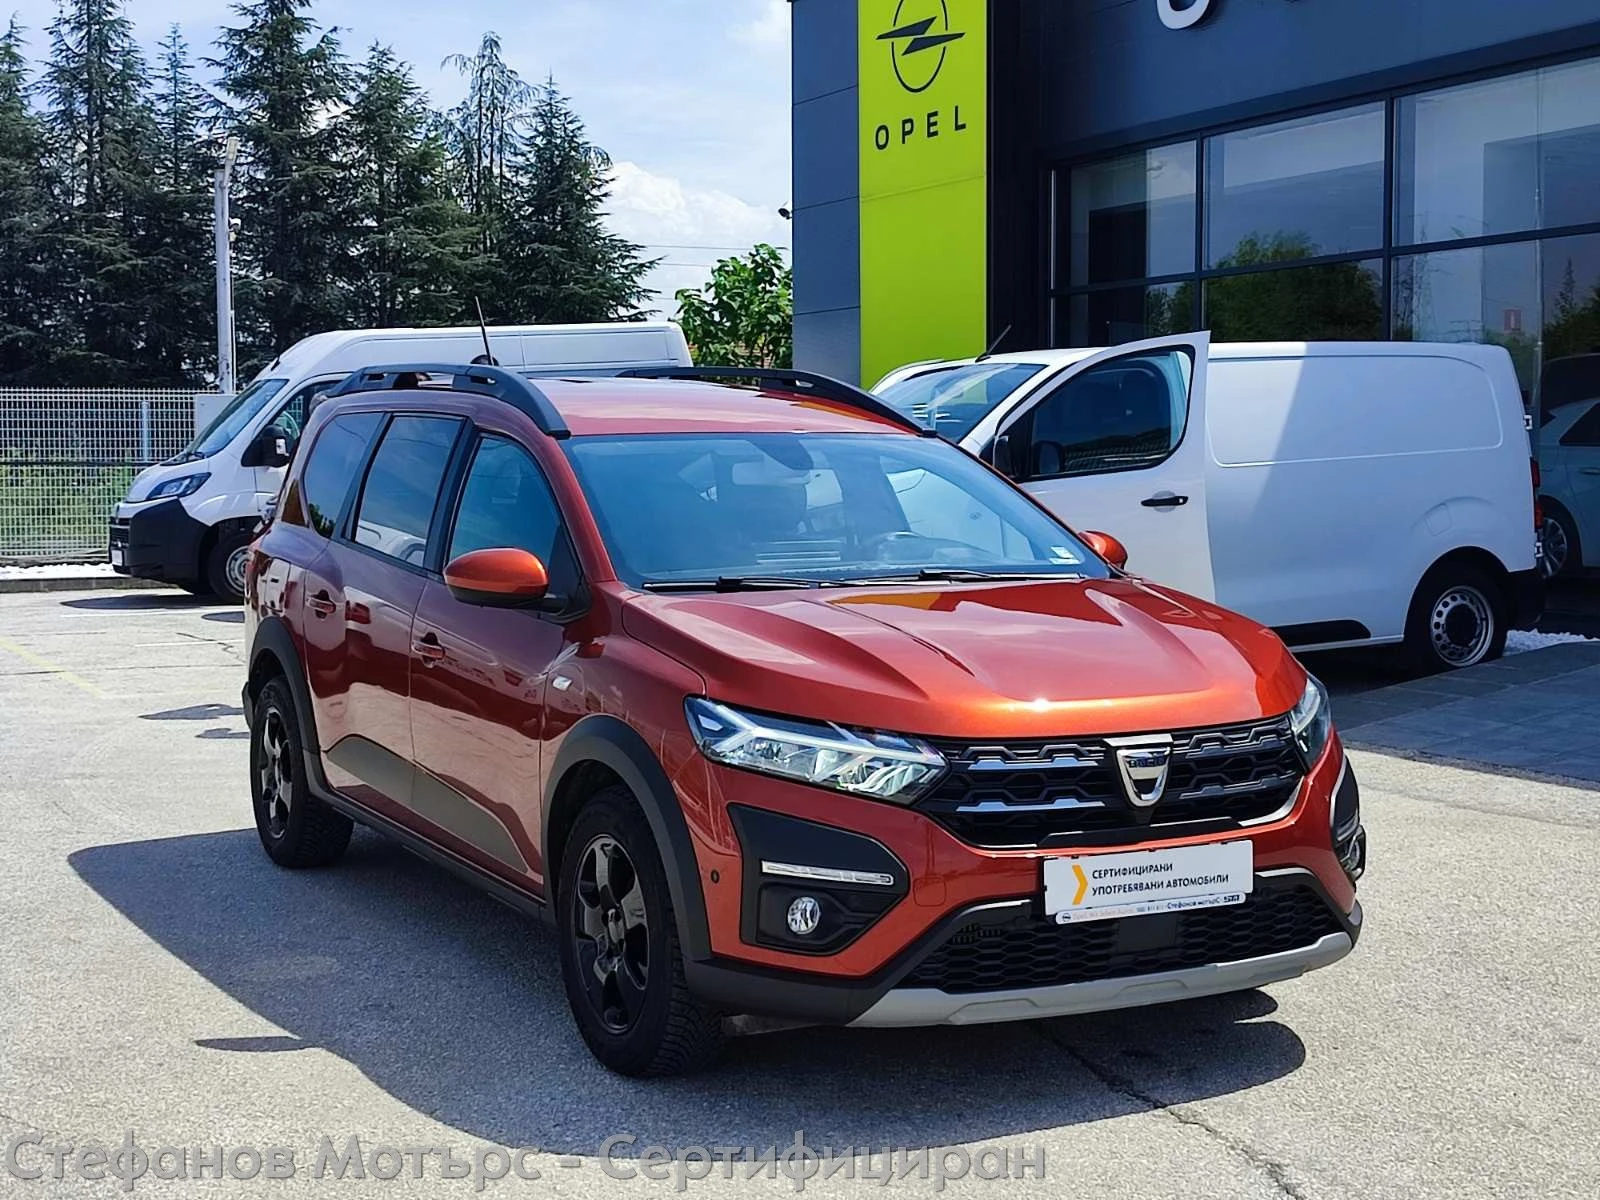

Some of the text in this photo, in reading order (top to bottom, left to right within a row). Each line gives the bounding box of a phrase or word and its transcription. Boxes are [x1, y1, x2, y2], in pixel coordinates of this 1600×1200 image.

[875, 105, 967, 151] OPEL
[1092, 863, 1173, 879] СЕРТИФИЦИРАНИ
[1092, 874, 1229, 896] УПОТРЕБЯВАНИ АВТОМОБИЛИ
